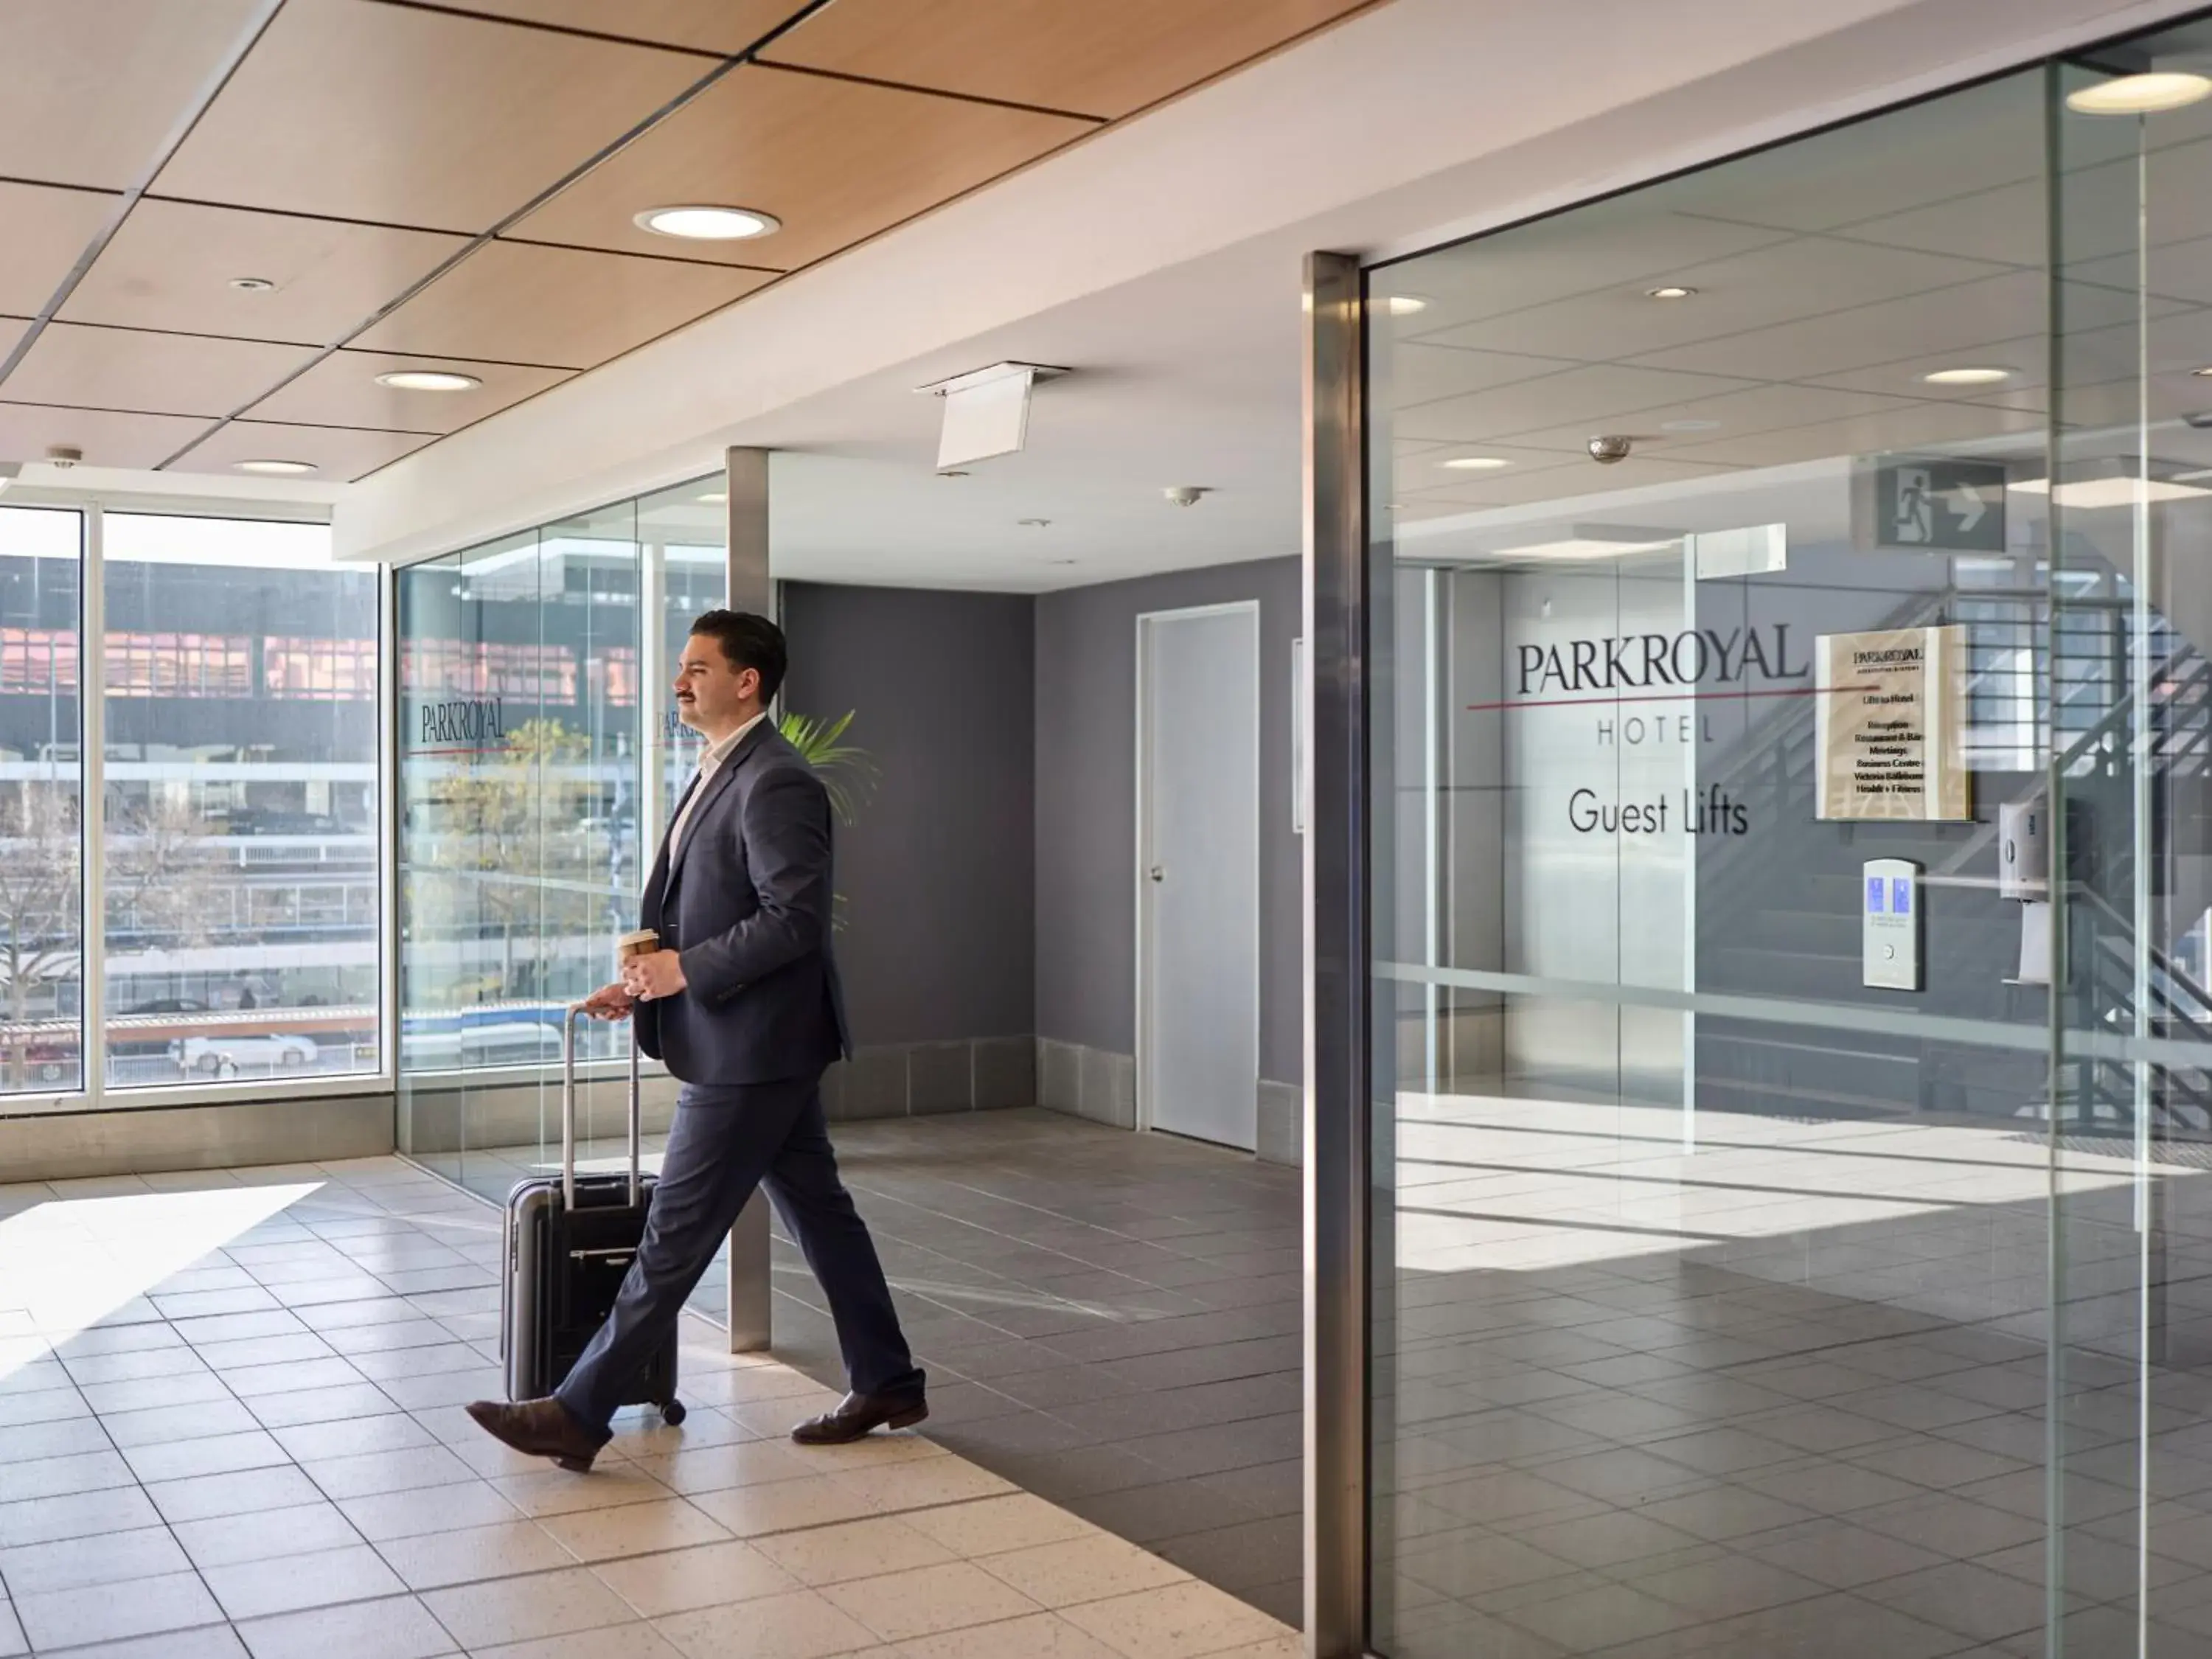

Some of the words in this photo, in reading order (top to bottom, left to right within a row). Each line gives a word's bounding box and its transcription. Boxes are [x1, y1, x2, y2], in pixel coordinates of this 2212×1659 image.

[1517, 623, 1811, 695] PARKROYAL
[421, 697, 505, 743] PARKROYAL
[1597, 714, 1715, 745] HOTEL
[1869, 745, 1908, 757] Meetings
[1853, 771, 1885, 781] Victoria
[1569, 788, 1669, 833] Guest
[1684, 783, 1749, 836] Lifts
